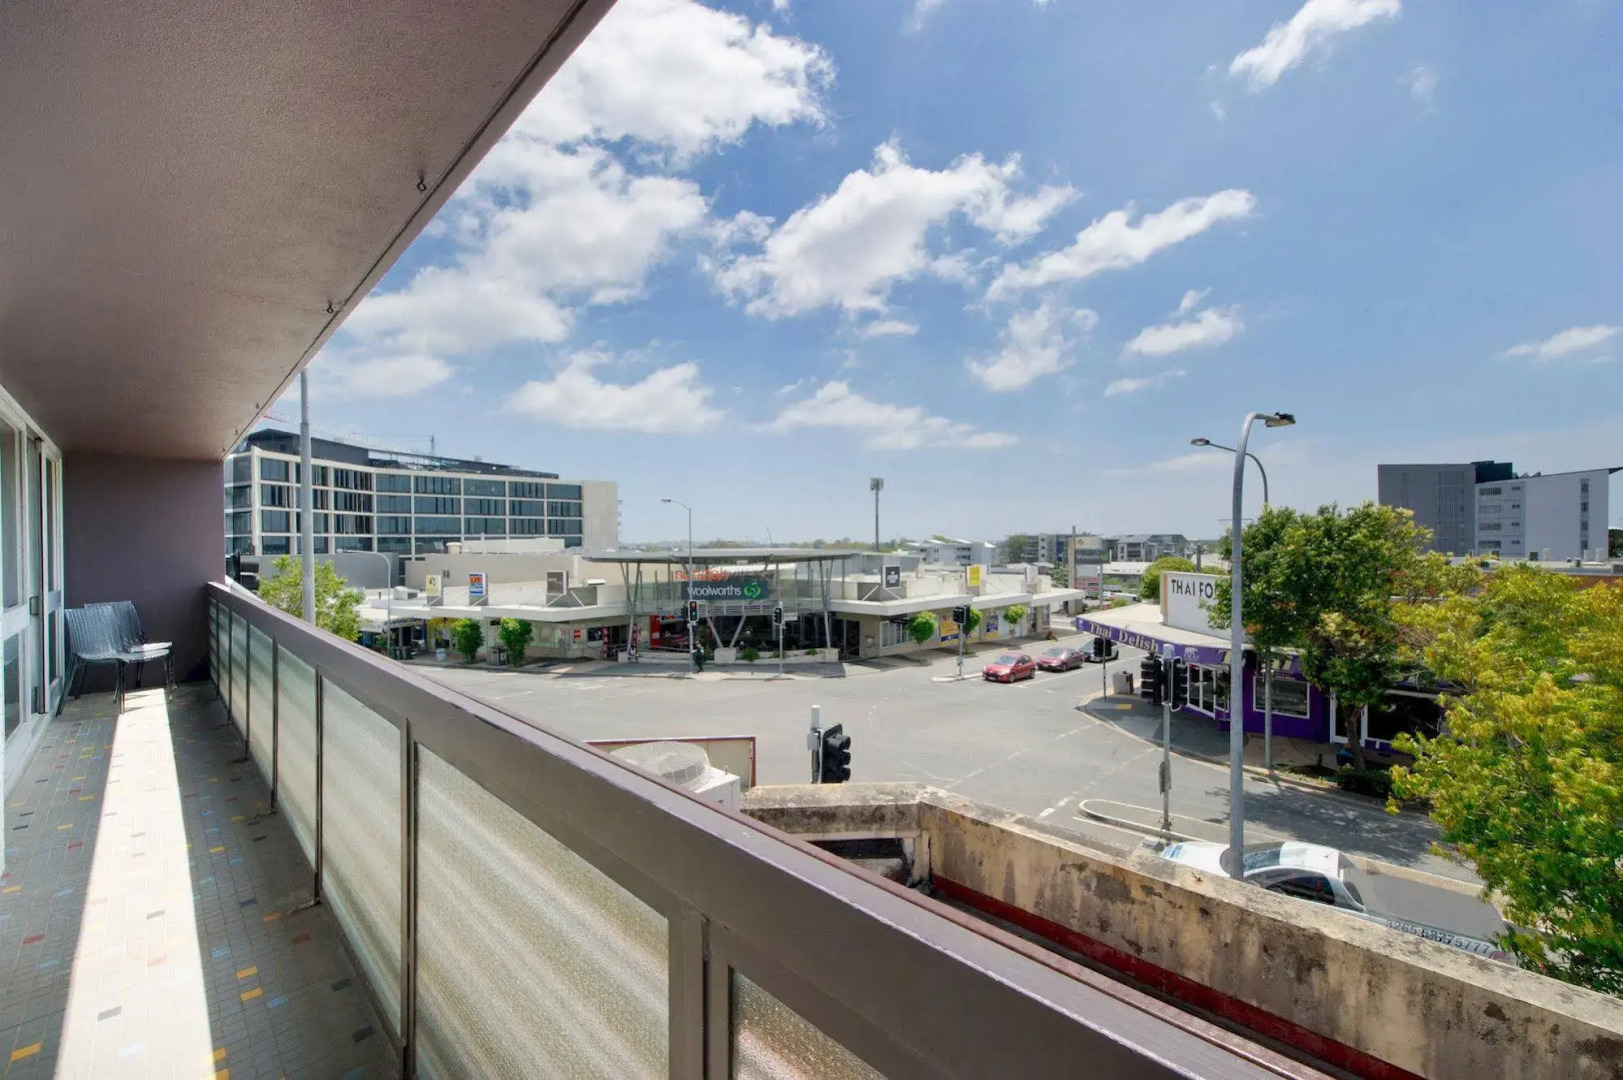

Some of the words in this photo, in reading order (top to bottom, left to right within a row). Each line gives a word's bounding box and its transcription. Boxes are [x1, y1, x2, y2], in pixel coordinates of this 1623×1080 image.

[1171, 579, 1195, 596] THAI
[1199, 581, 1217, 599] FO
[1089, 621, 1112, 639] Thai
[1118, 629, 1159, 652] Delish
